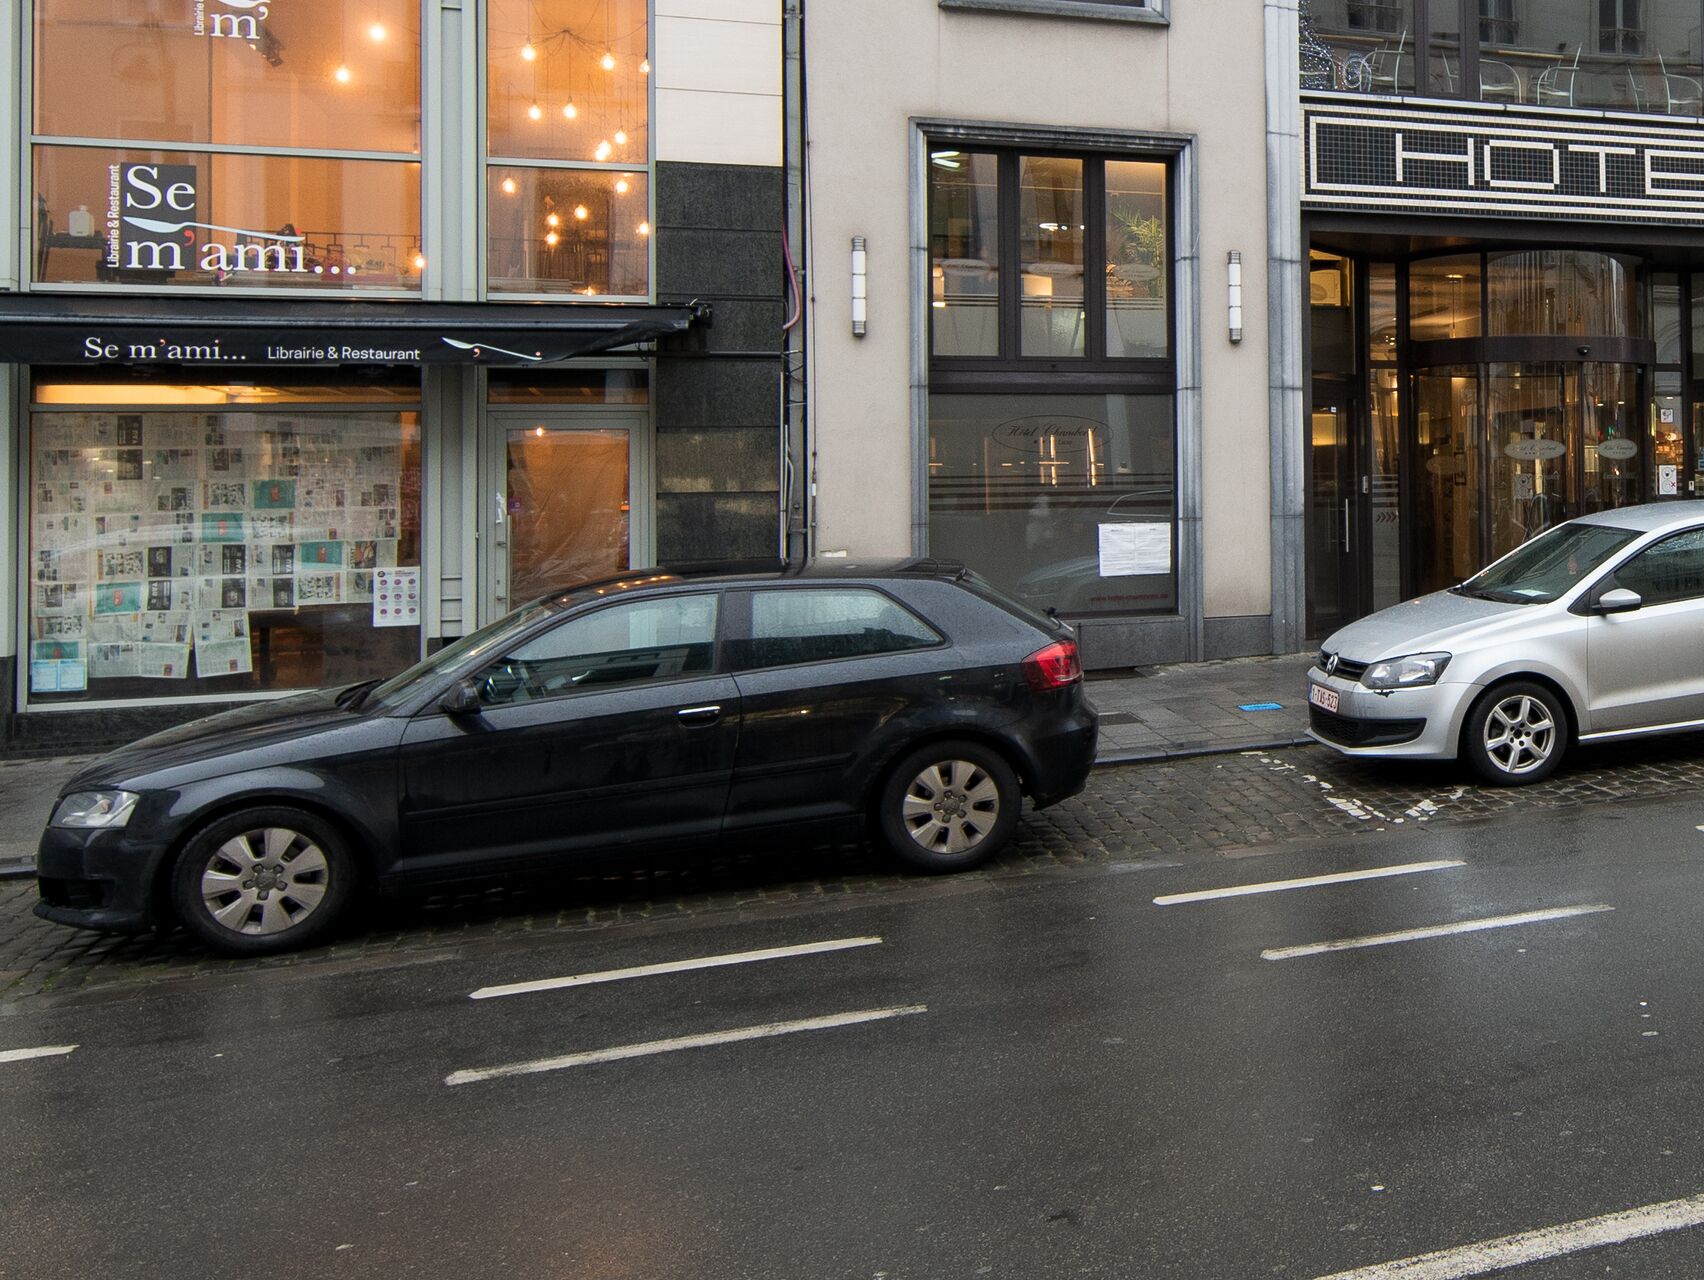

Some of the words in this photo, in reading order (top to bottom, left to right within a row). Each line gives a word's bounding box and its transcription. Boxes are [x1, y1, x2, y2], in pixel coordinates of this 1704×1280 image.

[193, 3, 205, 36] Librairie
[106, 163, 120, 219] Restaurant
[126, 164, 196, 211] Se
[106, 220, 120, 229] &
[106, 229, 120, 269] Librairie
[84, 336, 119, 359] Se
[267, 345, 325, 360] Librairie
[326, 346, 339, 359] &
[341, 346, 421, 361] Restaurant
